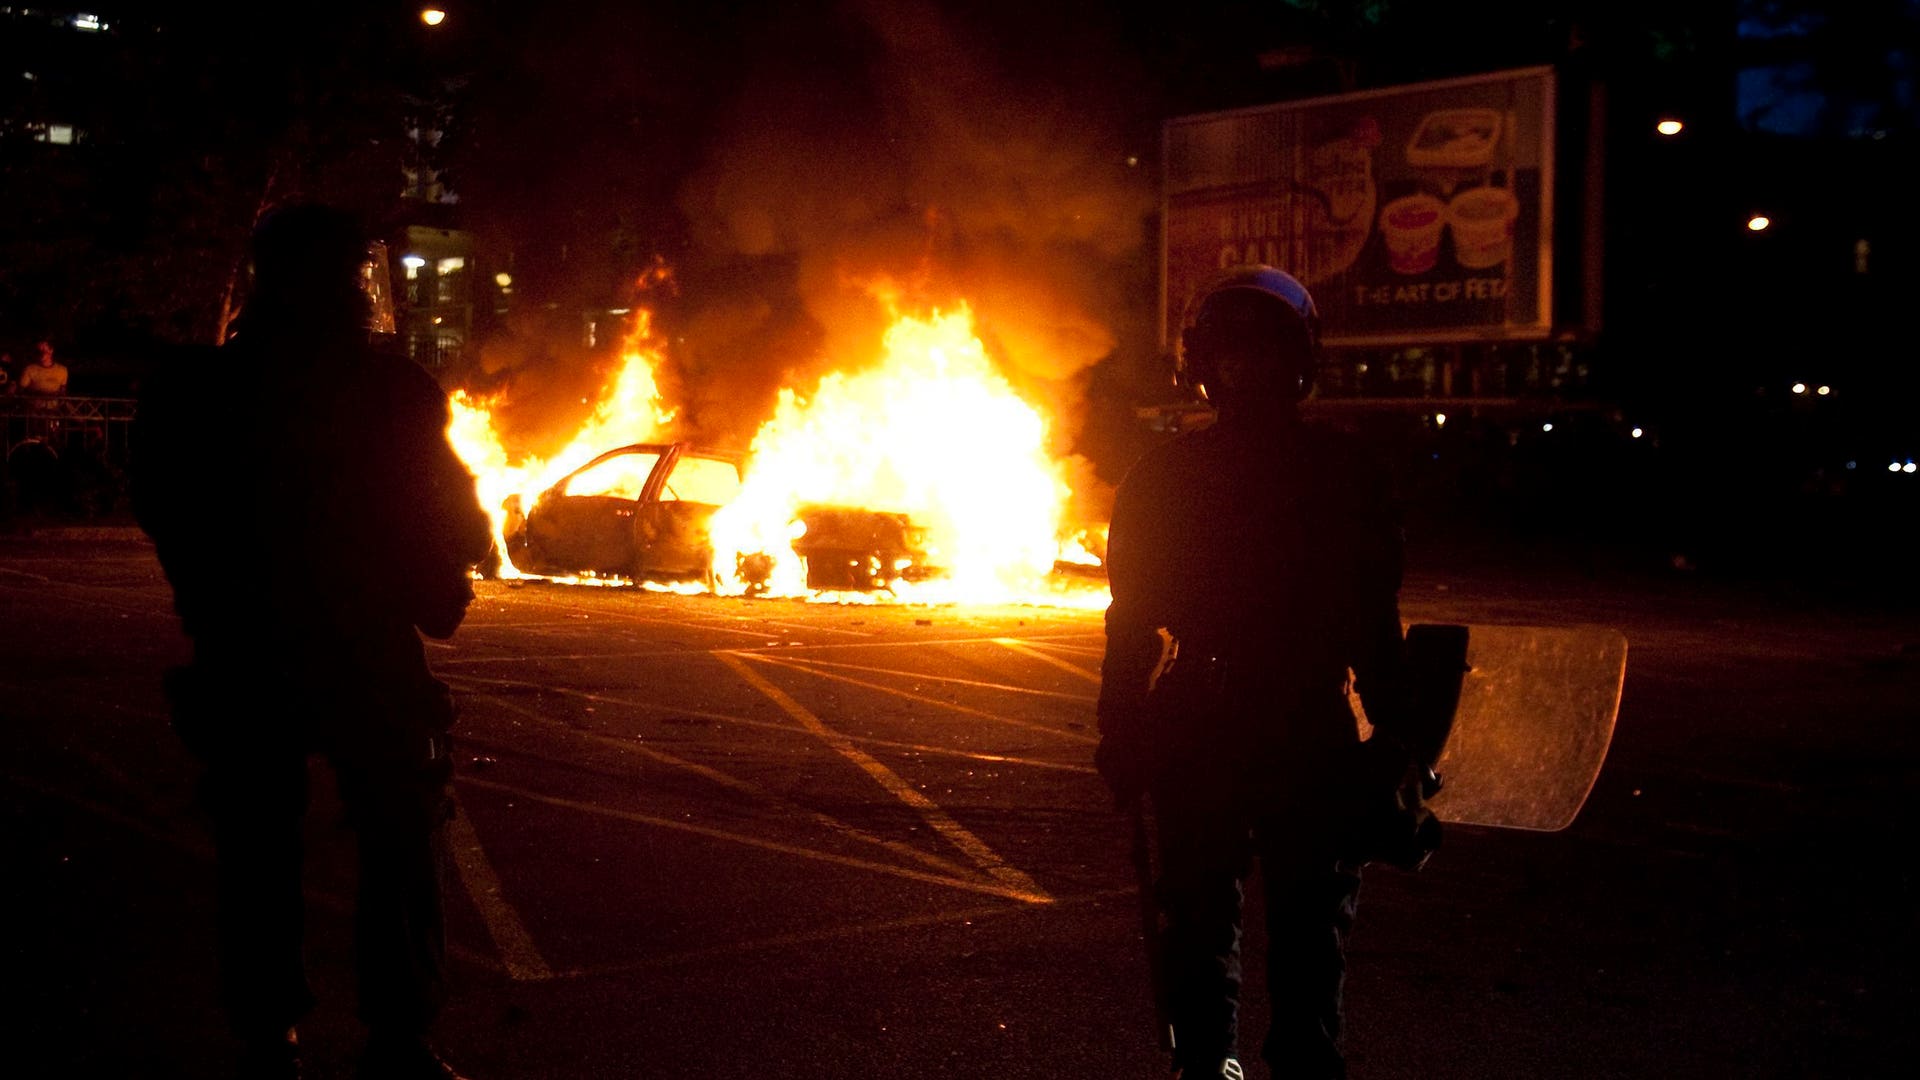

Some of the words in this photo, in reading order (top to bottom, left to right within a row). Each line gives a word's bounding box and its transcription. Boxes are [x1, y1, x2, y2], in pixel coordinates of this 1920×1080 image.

[1355, 284, 1390, 305] THE
[1395, 283, 1431, 303] ART
[1434, 281, 1462, 302] OF
